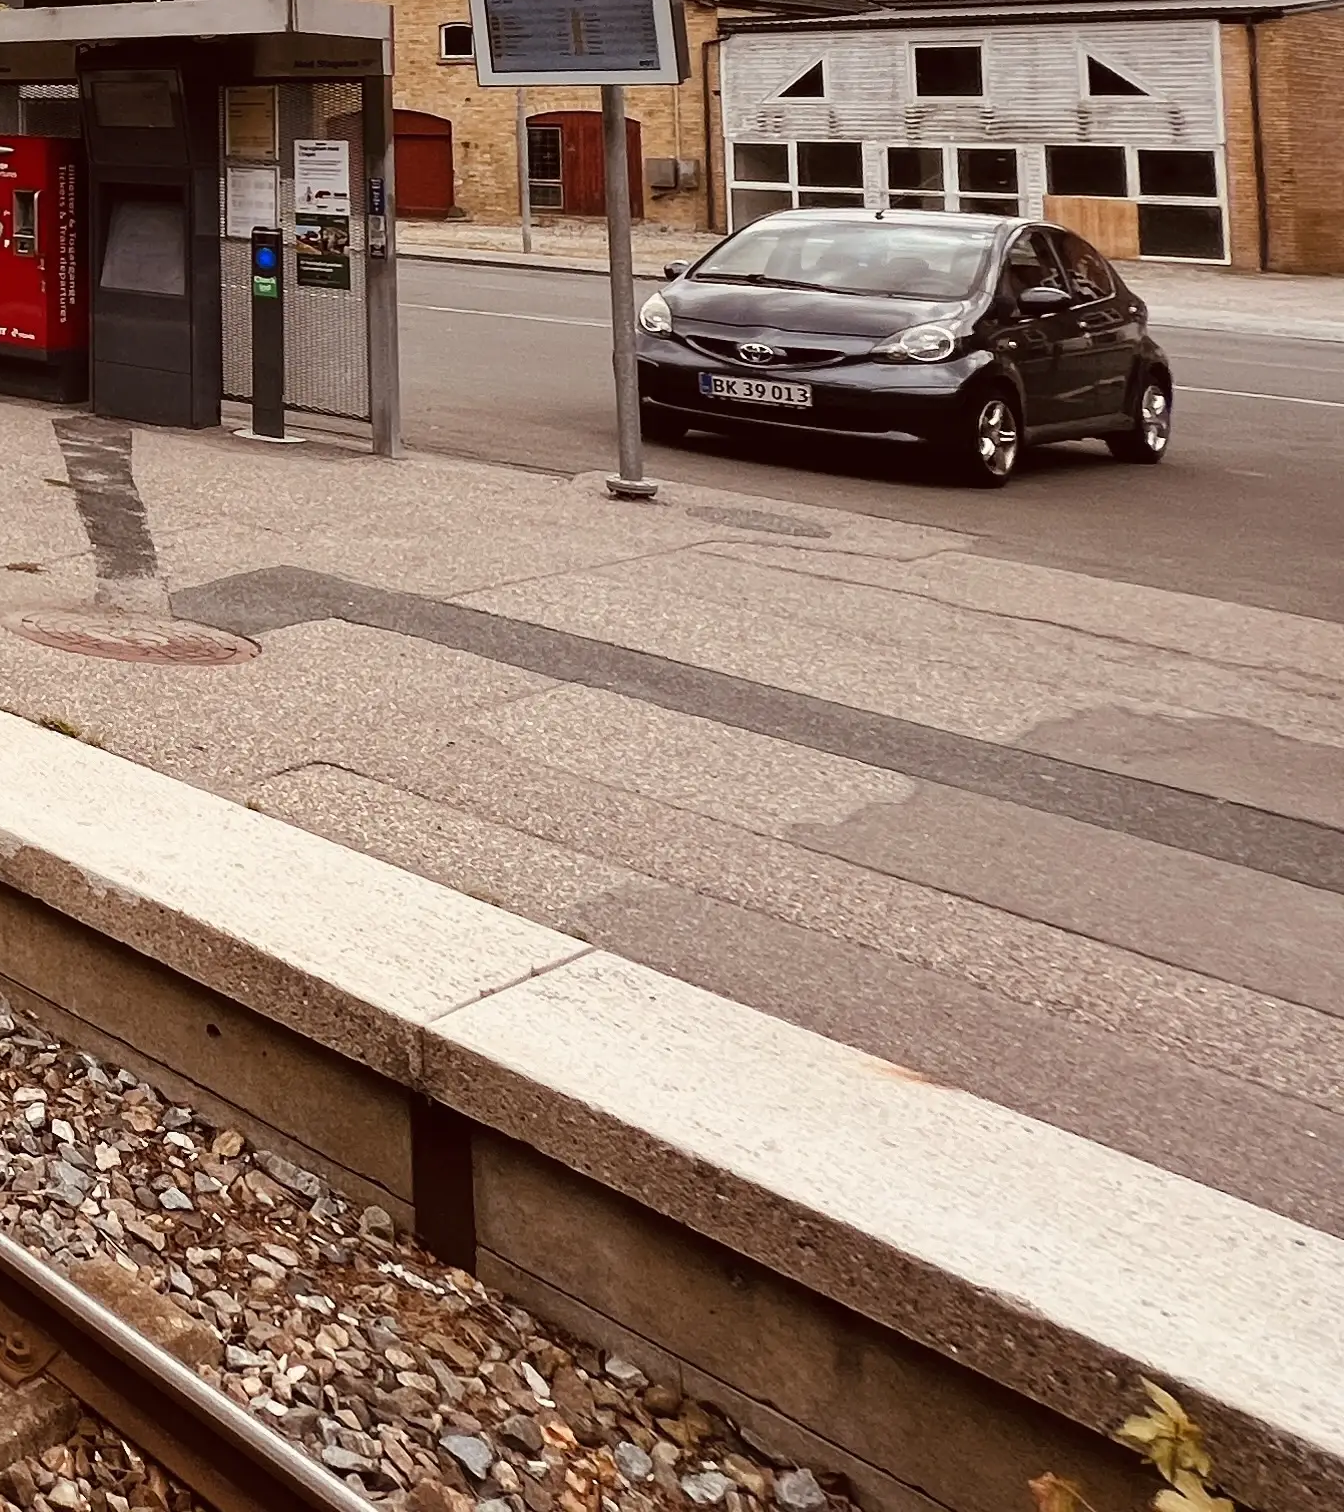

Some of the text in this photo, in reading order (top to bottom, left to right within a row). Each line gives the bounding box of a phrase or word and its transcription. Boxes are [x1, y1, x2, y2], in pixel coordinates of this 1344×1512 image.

[59, 225, 67, 253] Train
[58, 257, 67, 323] departures
[713, 378, 809, 402] BK 39 013
